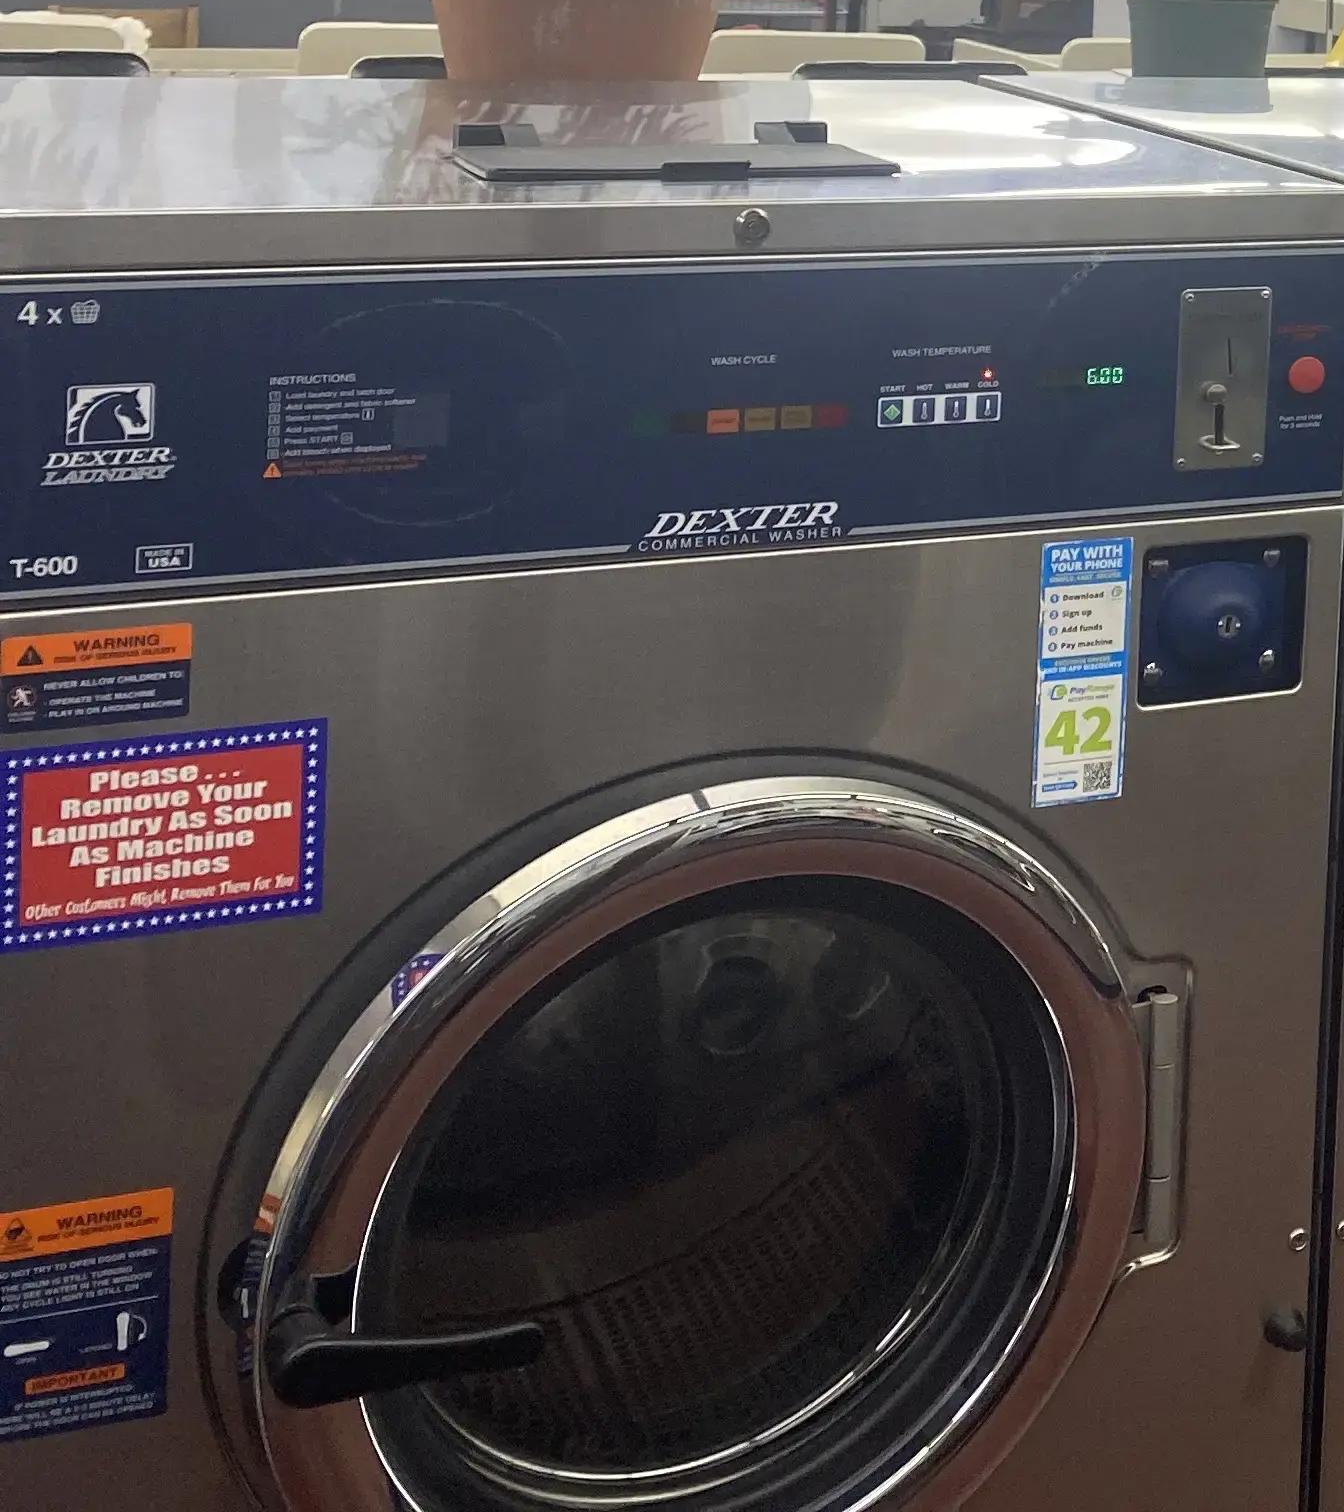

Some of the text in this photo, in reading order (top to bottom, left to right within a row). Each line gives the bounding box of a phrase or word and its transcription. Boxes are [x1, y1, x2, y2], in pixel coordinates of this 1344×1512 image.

[17, 300, 39, 325] 4
[710, 354, 777, 367] WASH CYCLE
[892, 345, 992, 359] WASH TEMPERATURE
[269, 373, 357, 386] INSTRUCTIONS
[42, 448, 171, 470] DEXTER
[40, 464, 175, 486] LAUNDRY
[645, 500, 840, 538] DEXTER
[637, 525, 842, 553] COMMERCIAL WASHER
[1051, 544, 1123, 563] PAY WITH
[9, 555, 181, 578] T-600 USA
[1050, 557, 1123, 573] YOUR PHONE
[1062, 591, 1105, 602] Download
[1062, 608, 1092, 619] Sign up
[1061, 623, 1103, 635] Add funds
[73, 634, 160, 652] WARNING
[1060, 638, 1113, 652] Pay machine
[1044, 705, 1113, 756] 42
[60, 780, 268, 820] Remove Your
[32, 800, 292, 848] Laundry As Soon
[69, 829, 255, 868] As Machine
[95, 855, 230, 888] Finishes
[25, 904, 61, 921] Other
[219, 880, 250, 897] Them
[253, 876, 272, 892] For
[275, 873, 295, 889] You
[56, 1205, 143, 1231] WARNING
[31, 1366, 120, 1392] IMPORTANT
